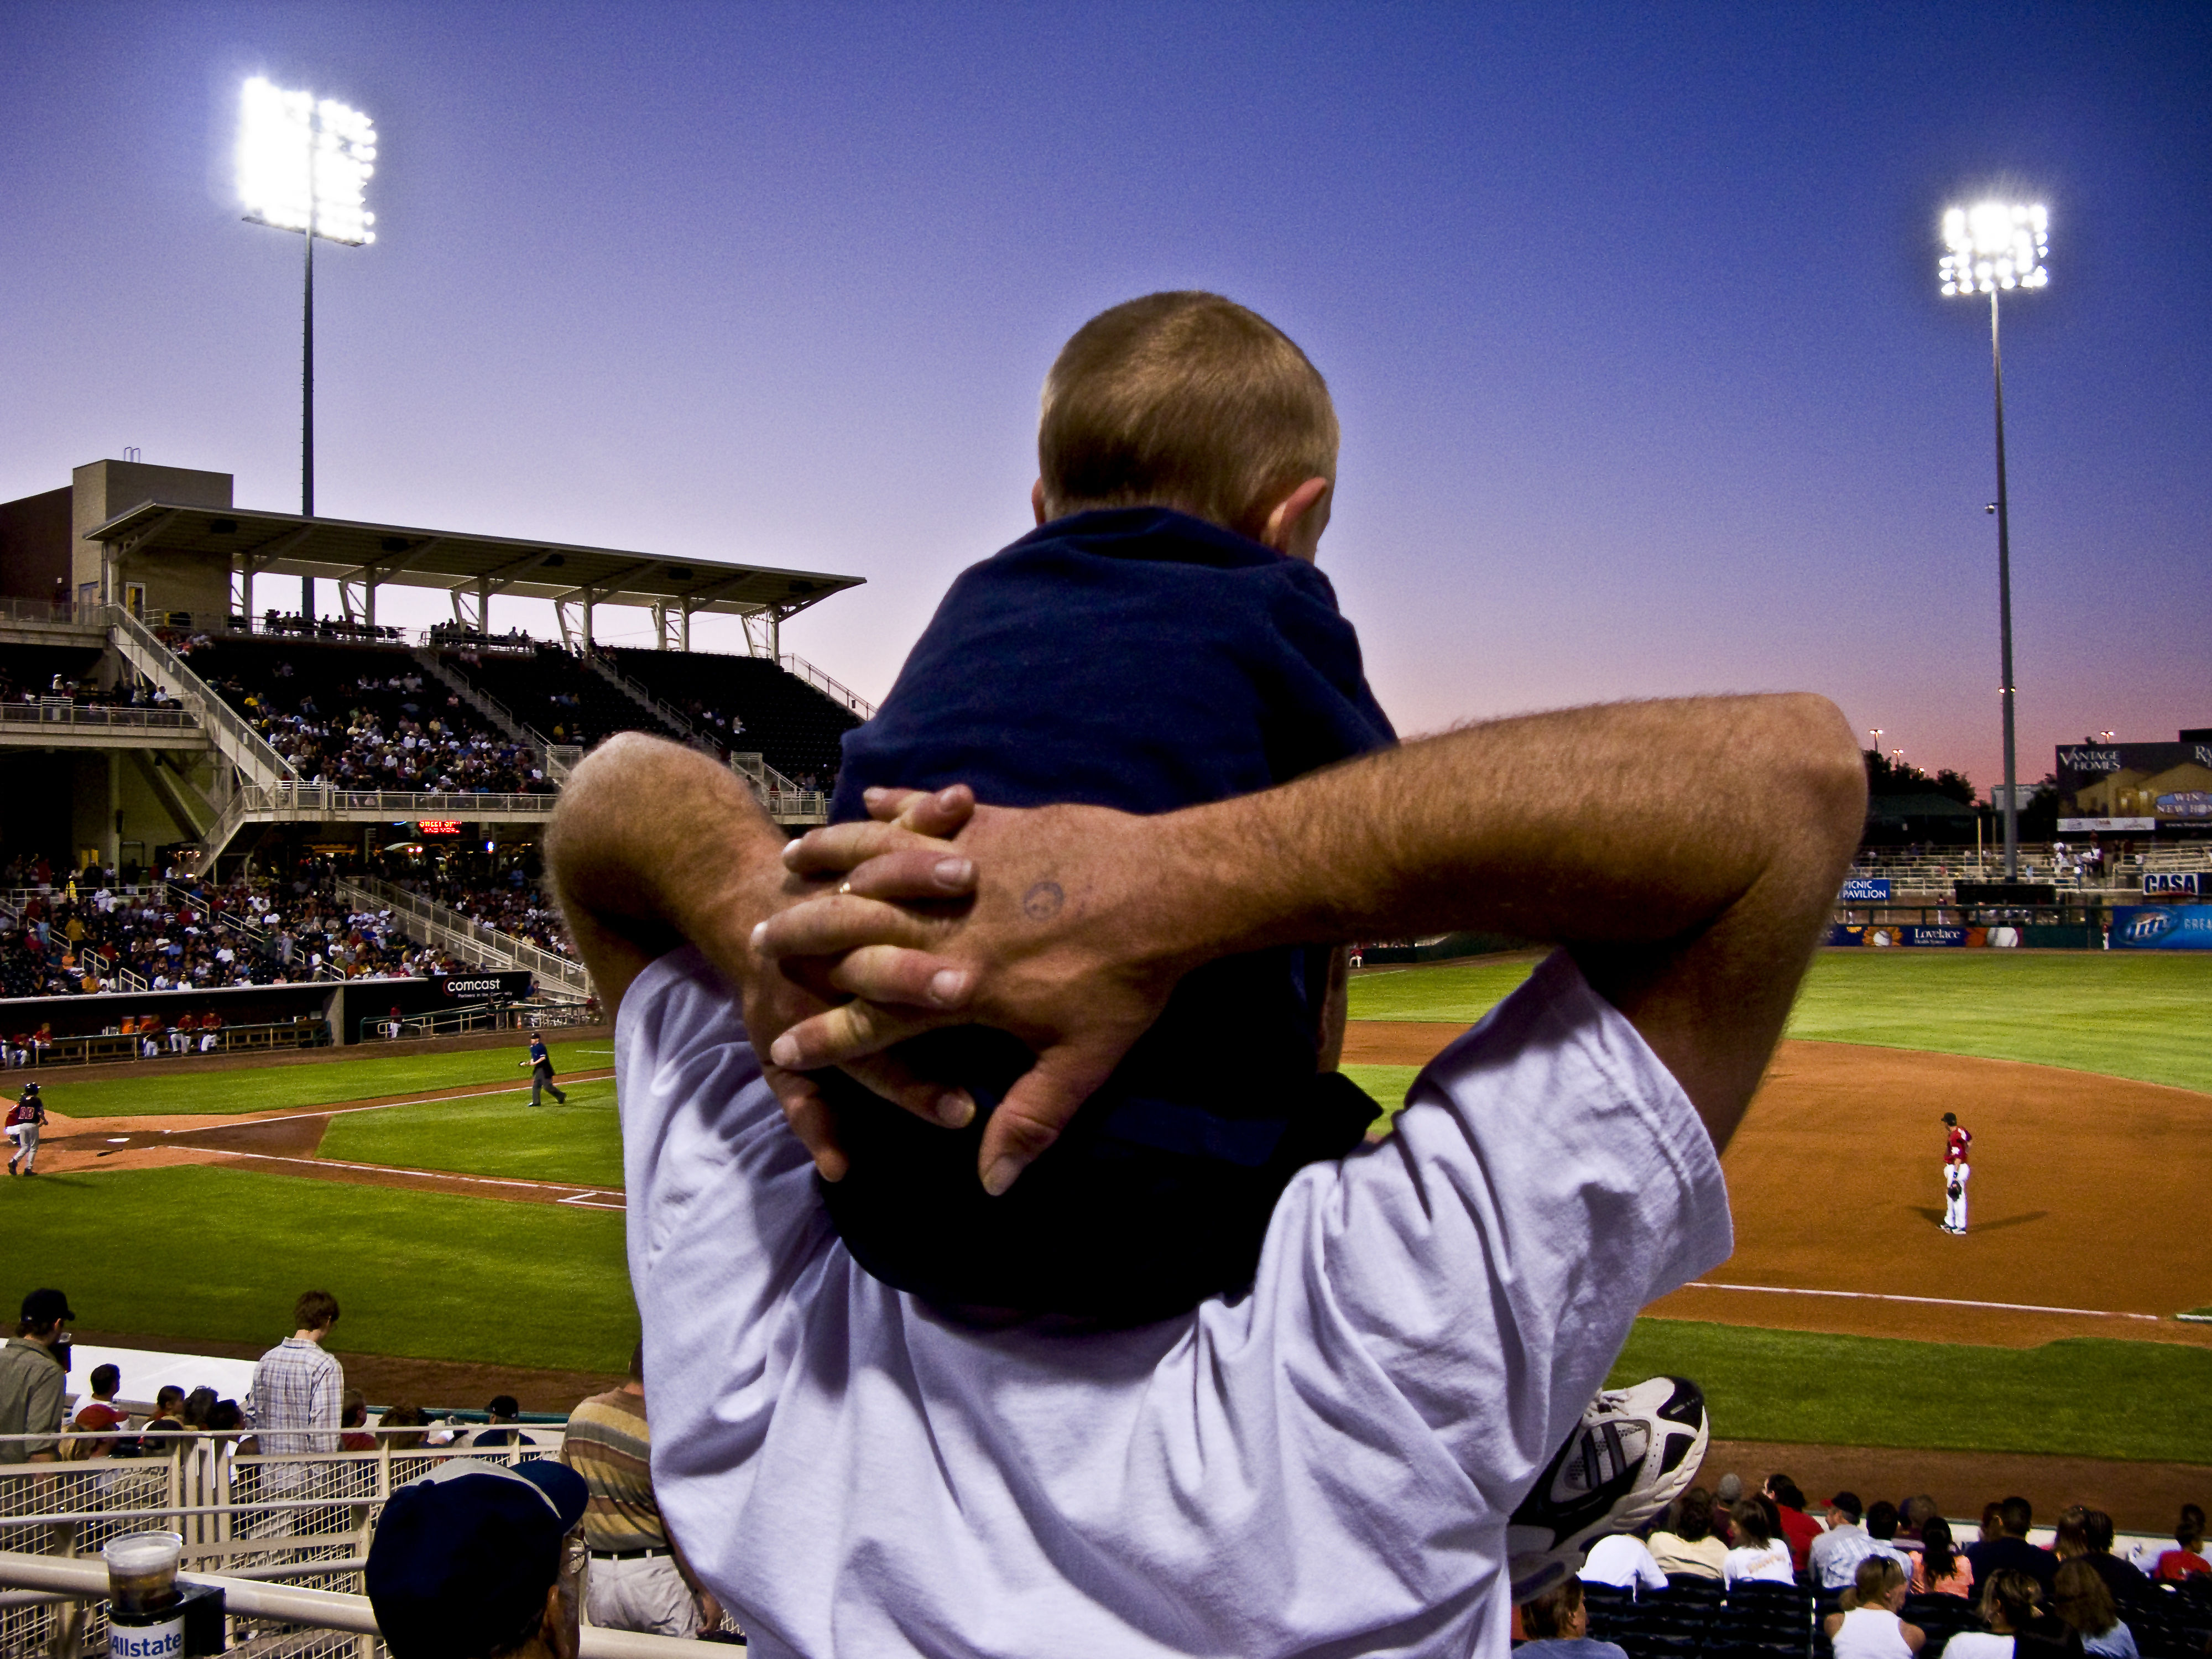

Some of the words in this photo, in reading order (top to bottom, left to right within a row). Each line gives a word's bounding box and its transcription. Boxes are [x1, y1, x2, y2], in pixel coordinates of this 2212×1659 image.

[2060, 747, 2120, 766] VANTAGE
[2074, 761, 2120, 770] HOMES
[1843, 880, 1872, 889] PICNIC
[2145, 874, 2196, 893] CASA
[1843, 889, 1886, 899] PAVILION
[1914, 928, 1960, 938] Lovelace
[447, 978, 500, 992] comcast
[112, 1633, 182, 1657] Allstate
